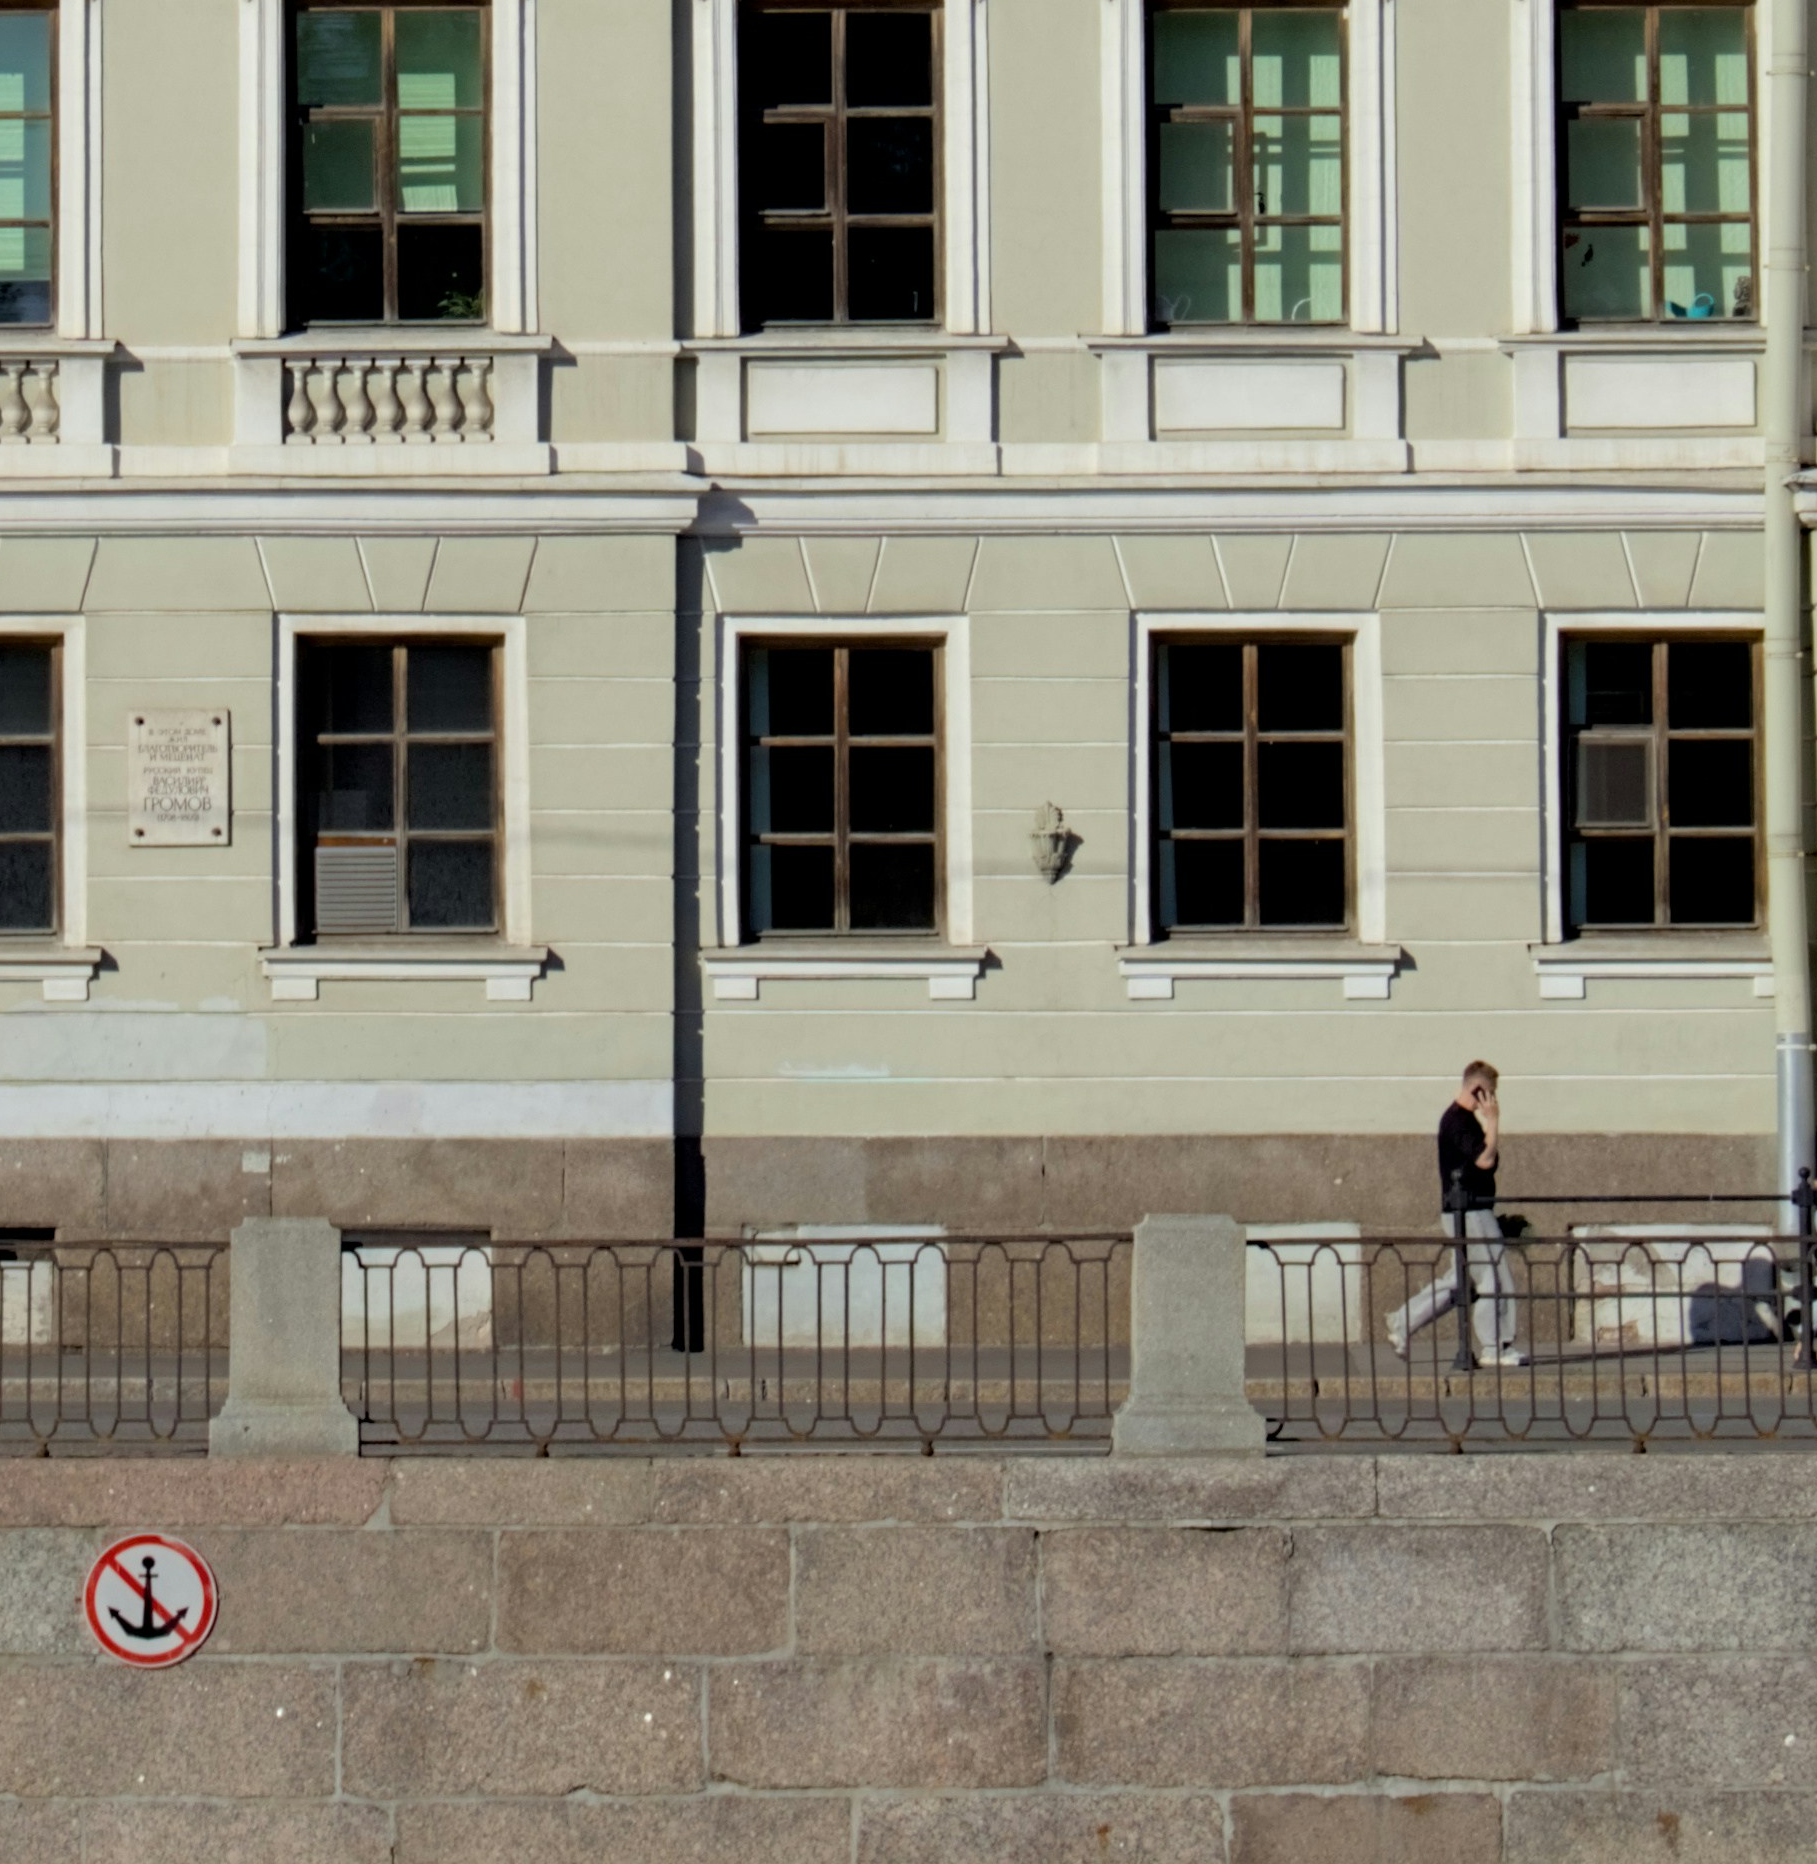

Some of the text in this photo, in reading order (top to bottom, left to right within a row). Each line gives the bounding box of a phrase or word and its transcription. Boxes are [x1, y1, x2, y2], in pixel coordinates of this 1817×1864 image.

[138, 744, 218, 753] БЛАГОТВОРИТЕЛЬ
[160, 753, 204, 761] МЕЦЕНАТ
[144, 797, 212, 812] ГРОМОВ
